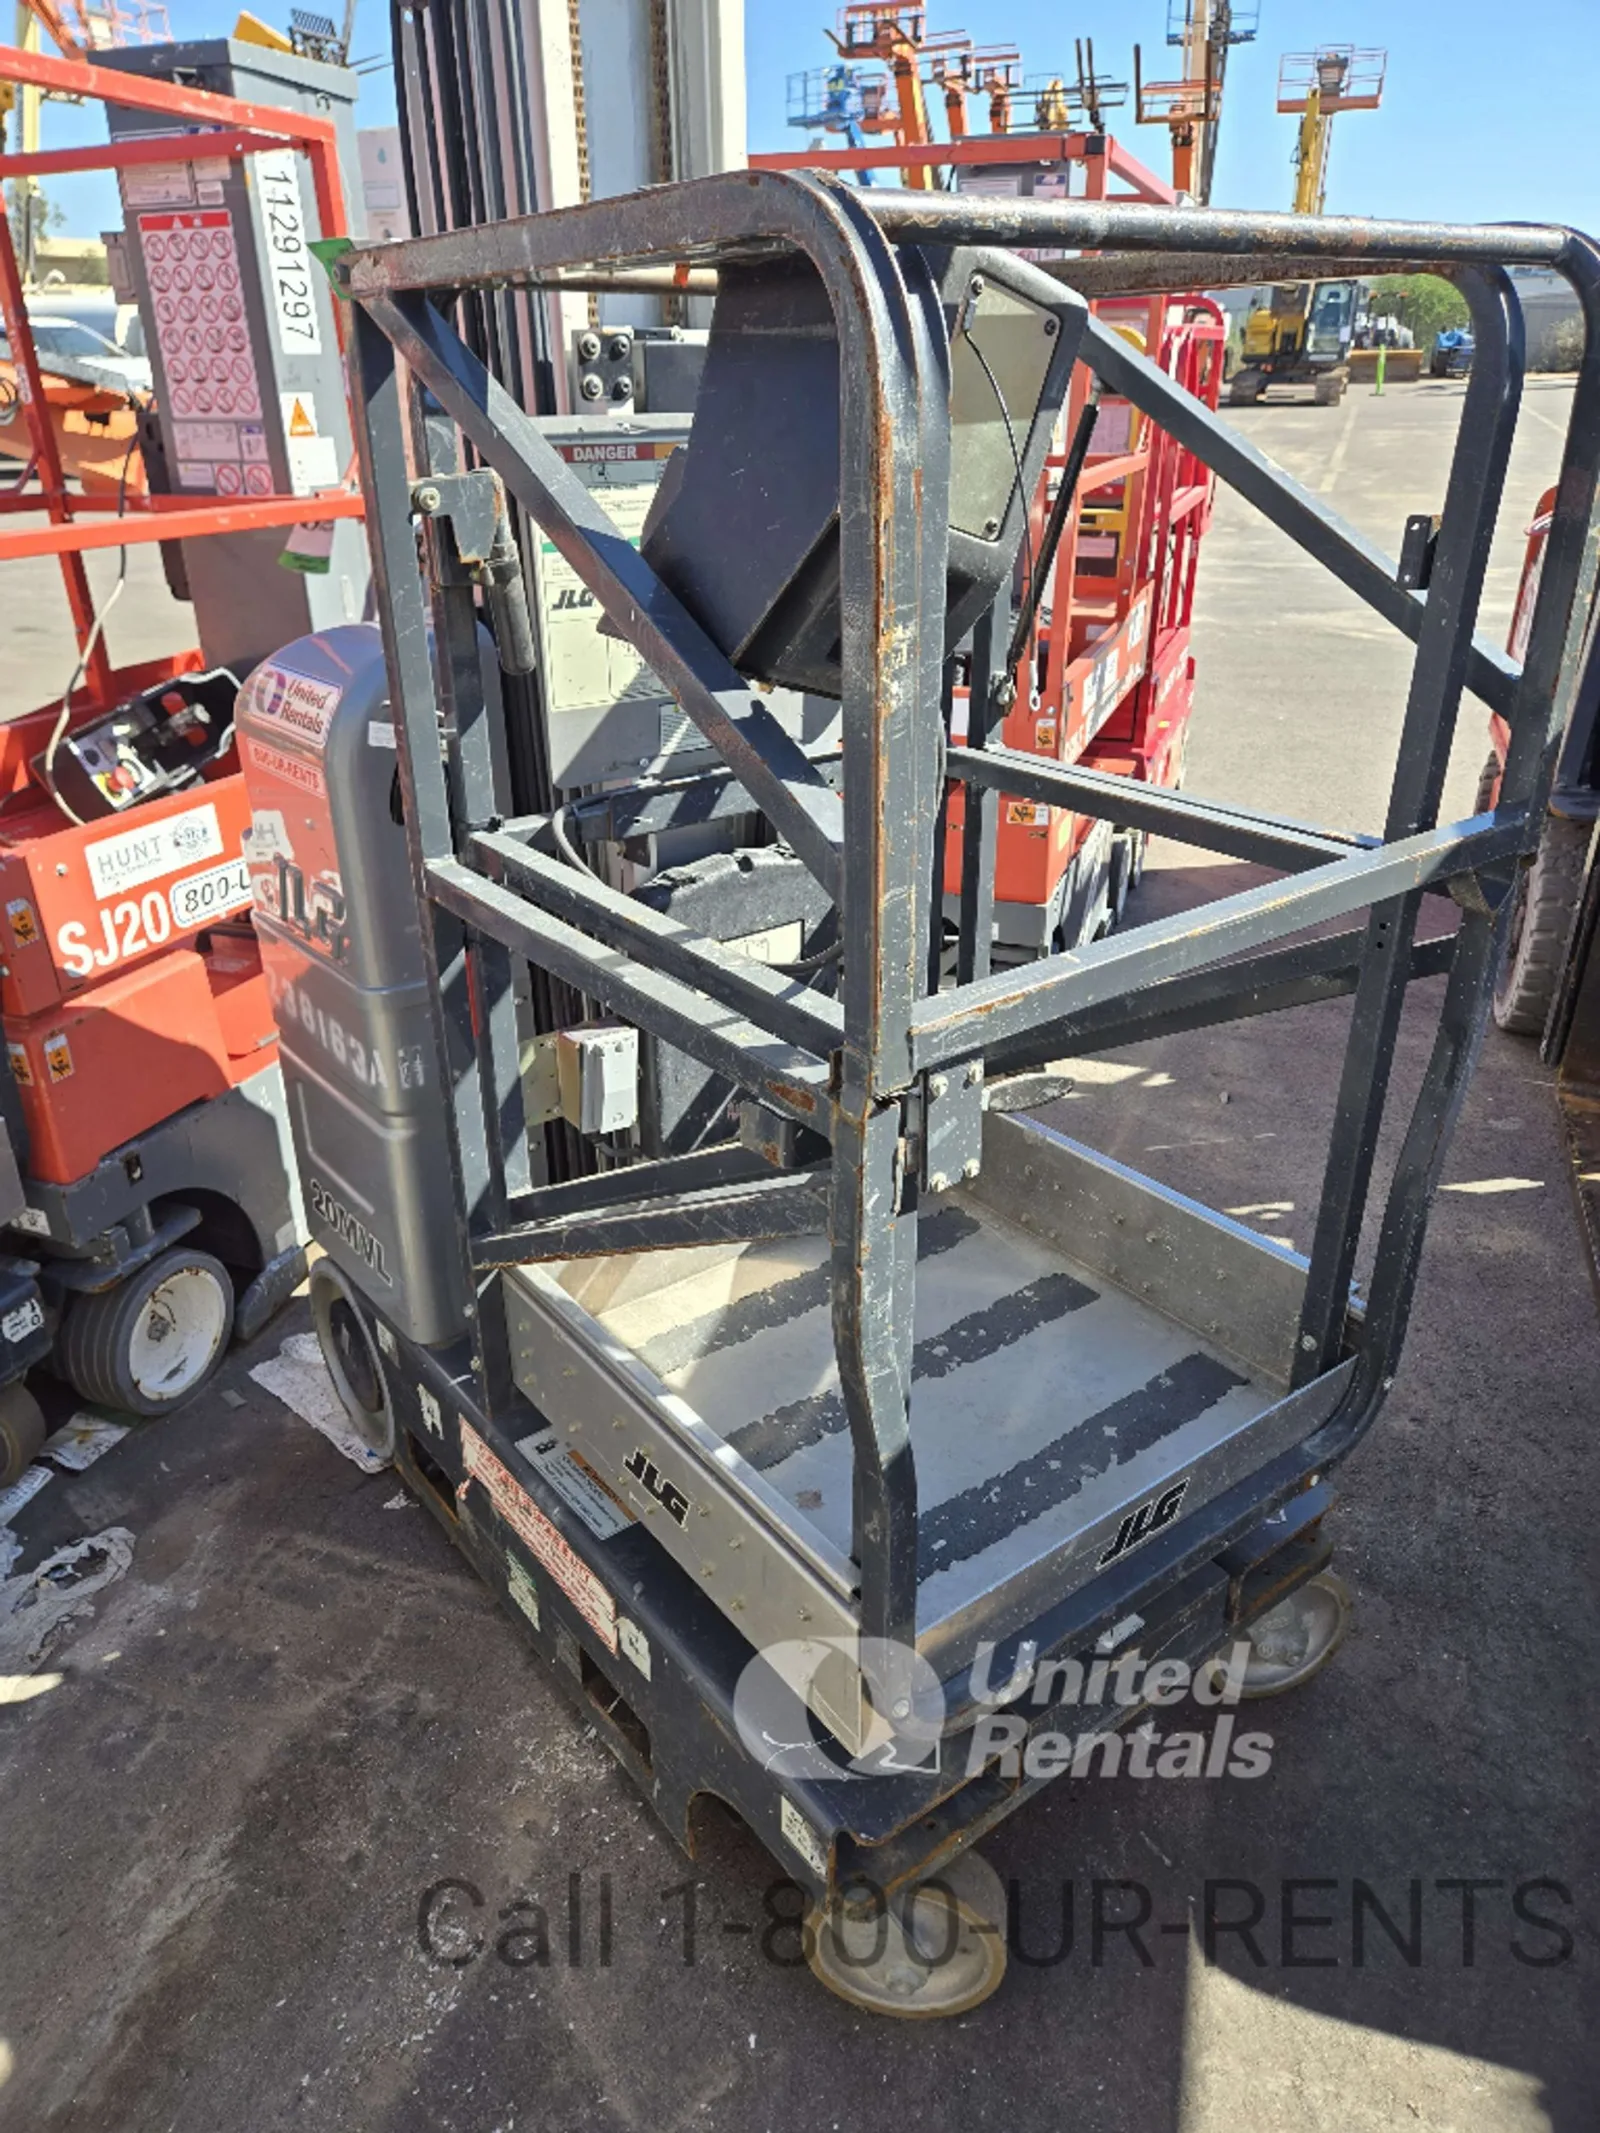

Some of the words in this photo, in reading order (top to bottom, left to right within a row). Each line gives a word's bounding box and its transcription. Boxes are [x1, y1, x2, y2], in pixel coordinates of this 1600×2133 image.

[263, 171, 314, 340] 11291297
[572, 446, 637, 461] DANGER
[552, 587, 597, 610] JLG
[281, 701, 324, 734] Rentals
[287, 679, 331, 709] United
[98, 835, 162, 875] HUNT
[57, 890, 171, 977] SJ20
[310, 1177, 393, 1288] 20MVL
[623, 1446, 690, 1528] JLG
[1095, 1476, 1190, 1571] JLG
